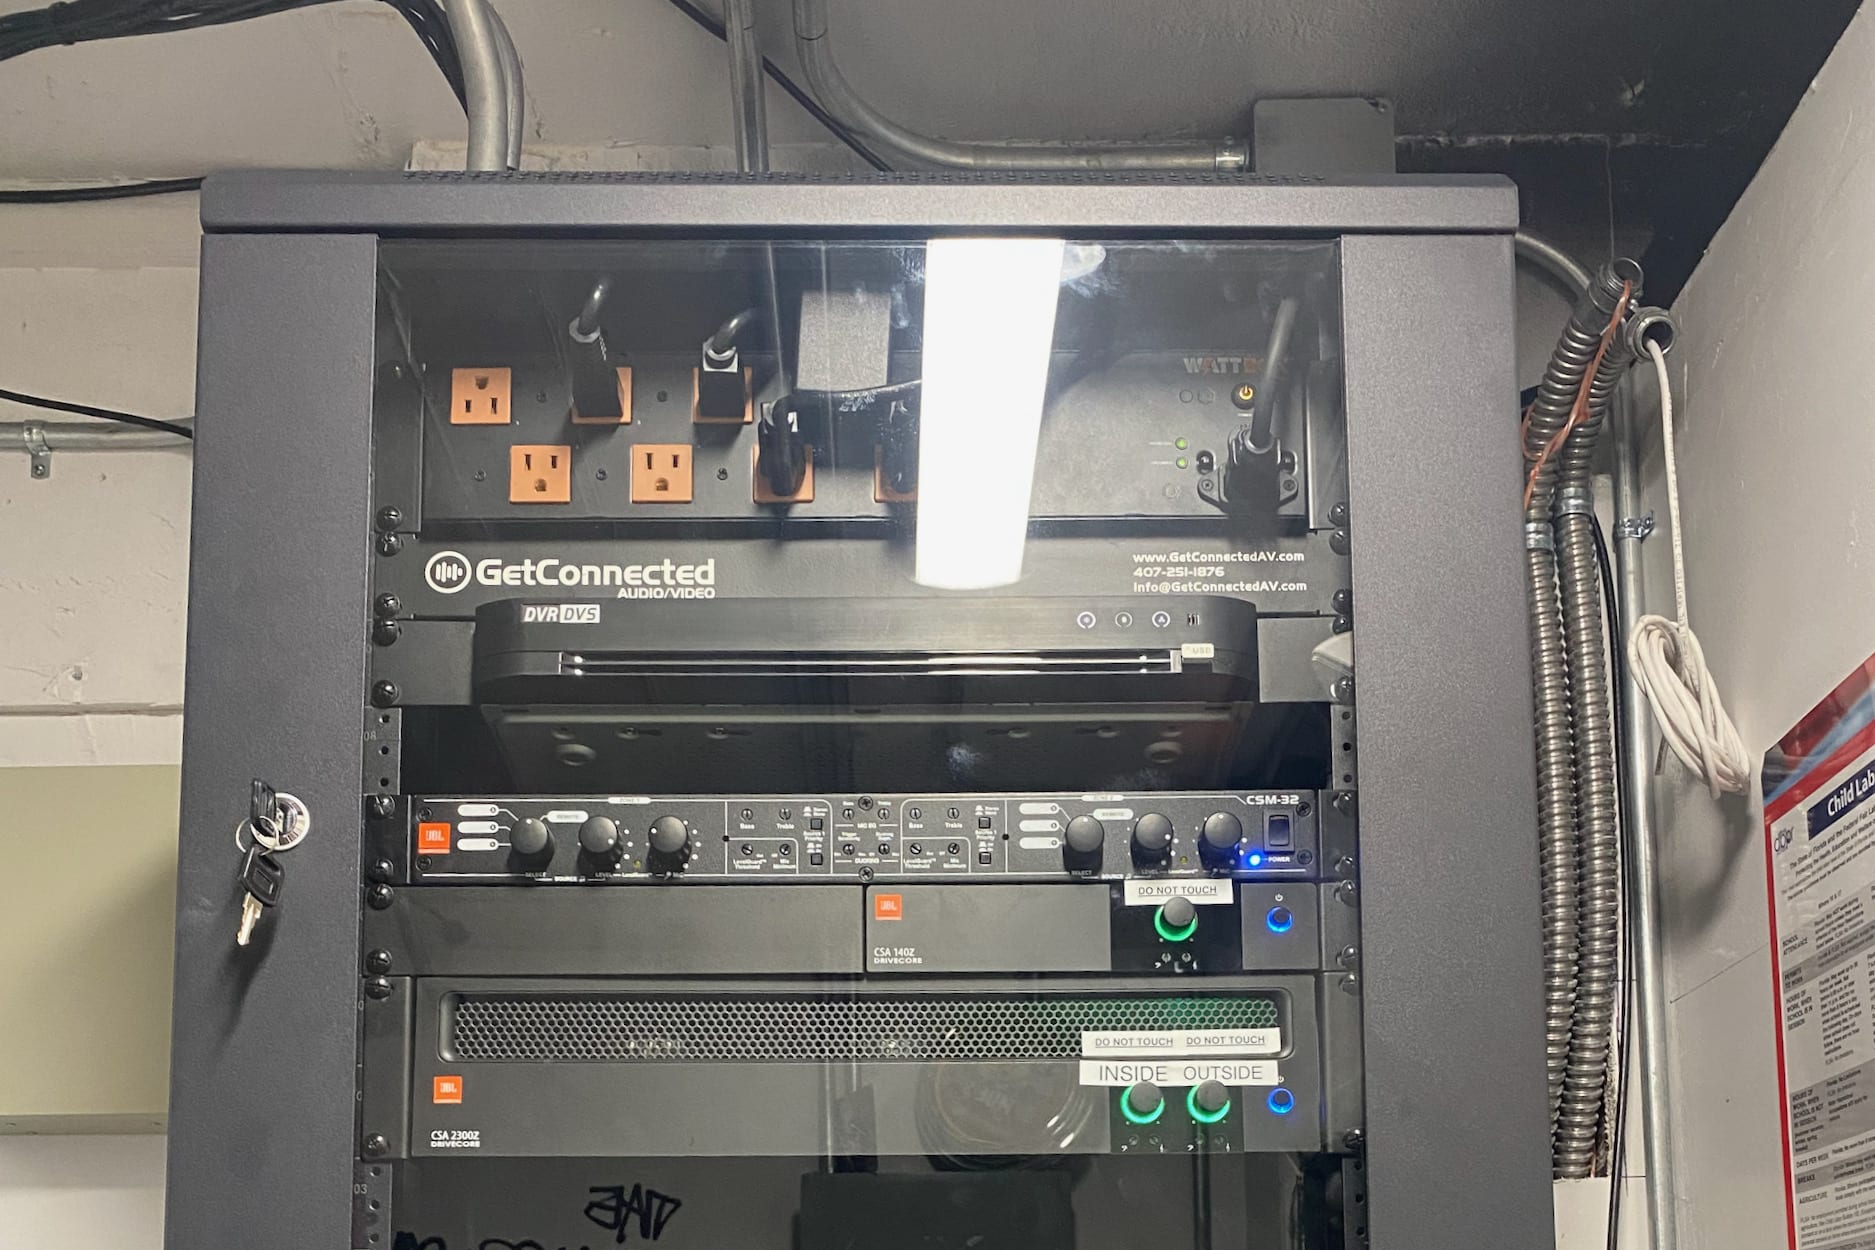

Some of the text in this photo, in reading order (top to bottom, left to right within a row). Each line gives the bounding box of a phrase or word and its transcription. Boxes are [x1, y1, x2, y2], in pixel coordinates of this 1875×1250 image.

[1133, 552, 1305, 564] www.GetConnectedAV.com
[475, 558, 715, 586] GetConnected
[1133, 566, 1225, 577] 407-251-1876
[617, 587, 716, 599] AUDIO/VIDEO
[524, 605, 597, 622] DVR DVS
[364, 731, 377, 741] 08
[1246, 795, 1299, 806] CSM-32
[1827, 783, 1856, 816] Child
[1138, 886, 1217, 895] DO NOT TOUCH
[874, 947, 915, 957] CSA 140Z
[1095, 1037, 1174, 1047] DO NOT TOUCH
[1186, 1035, 1265, 1045] DO NOT TOUCH
[1099, 1065, 1263, 1082] INSIDE OUTSIDE
[430, 1130, 480, 1140] CSA 2300Z
[354, 1184, 368, 1194] 03
